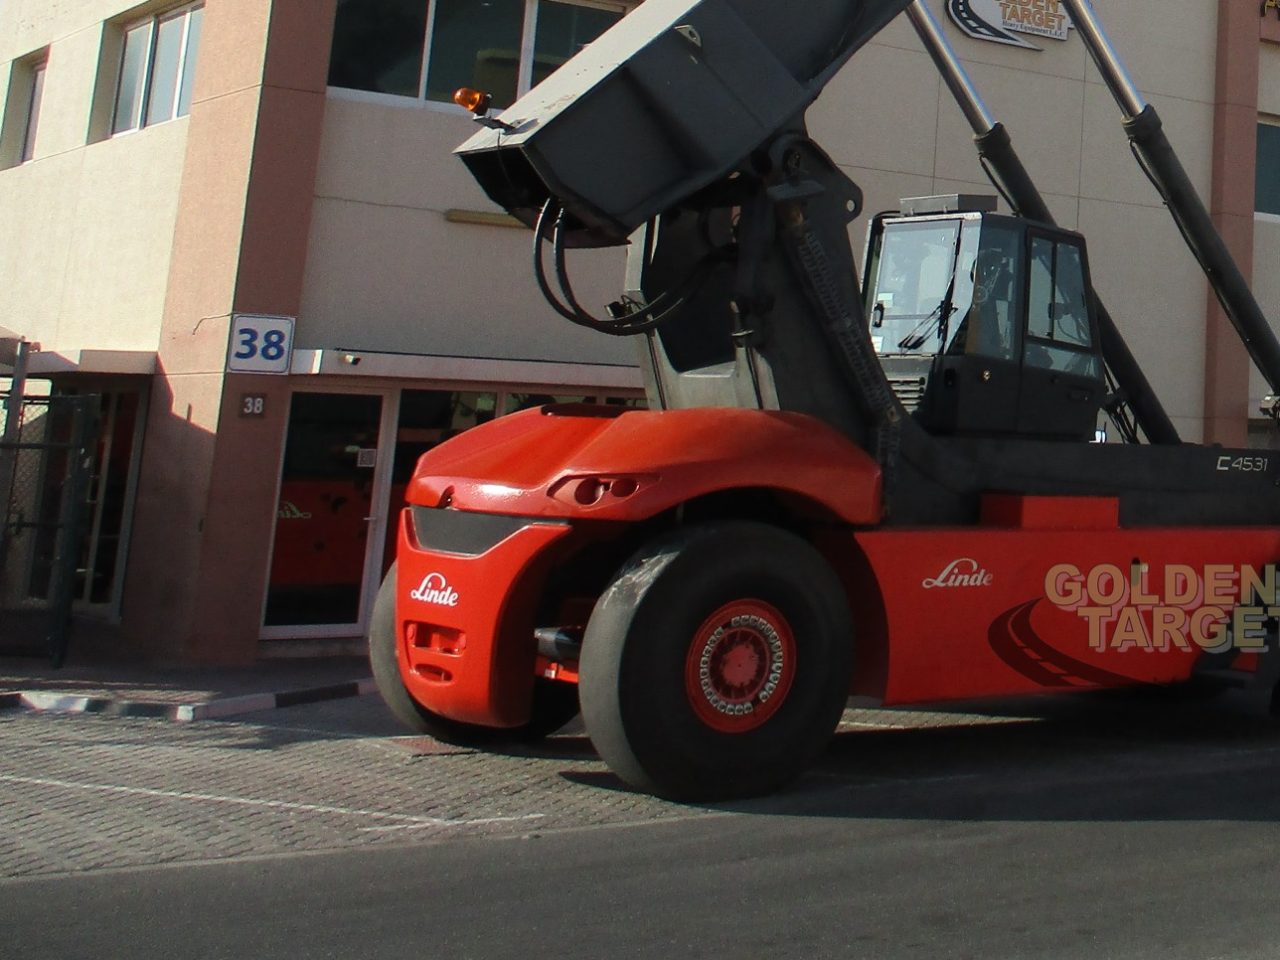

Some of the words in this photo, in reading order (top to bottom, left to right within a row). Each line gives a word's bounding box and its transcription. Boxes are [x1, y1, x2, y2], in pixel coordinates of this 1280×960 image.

[999, 2, 1066, 31] TARGET
[233, 327, 287, 361] 38
[243, 396, 264, 414] 38
[410, 571, 459, 607] Linde
[922, 557, 994, 589] Linde
